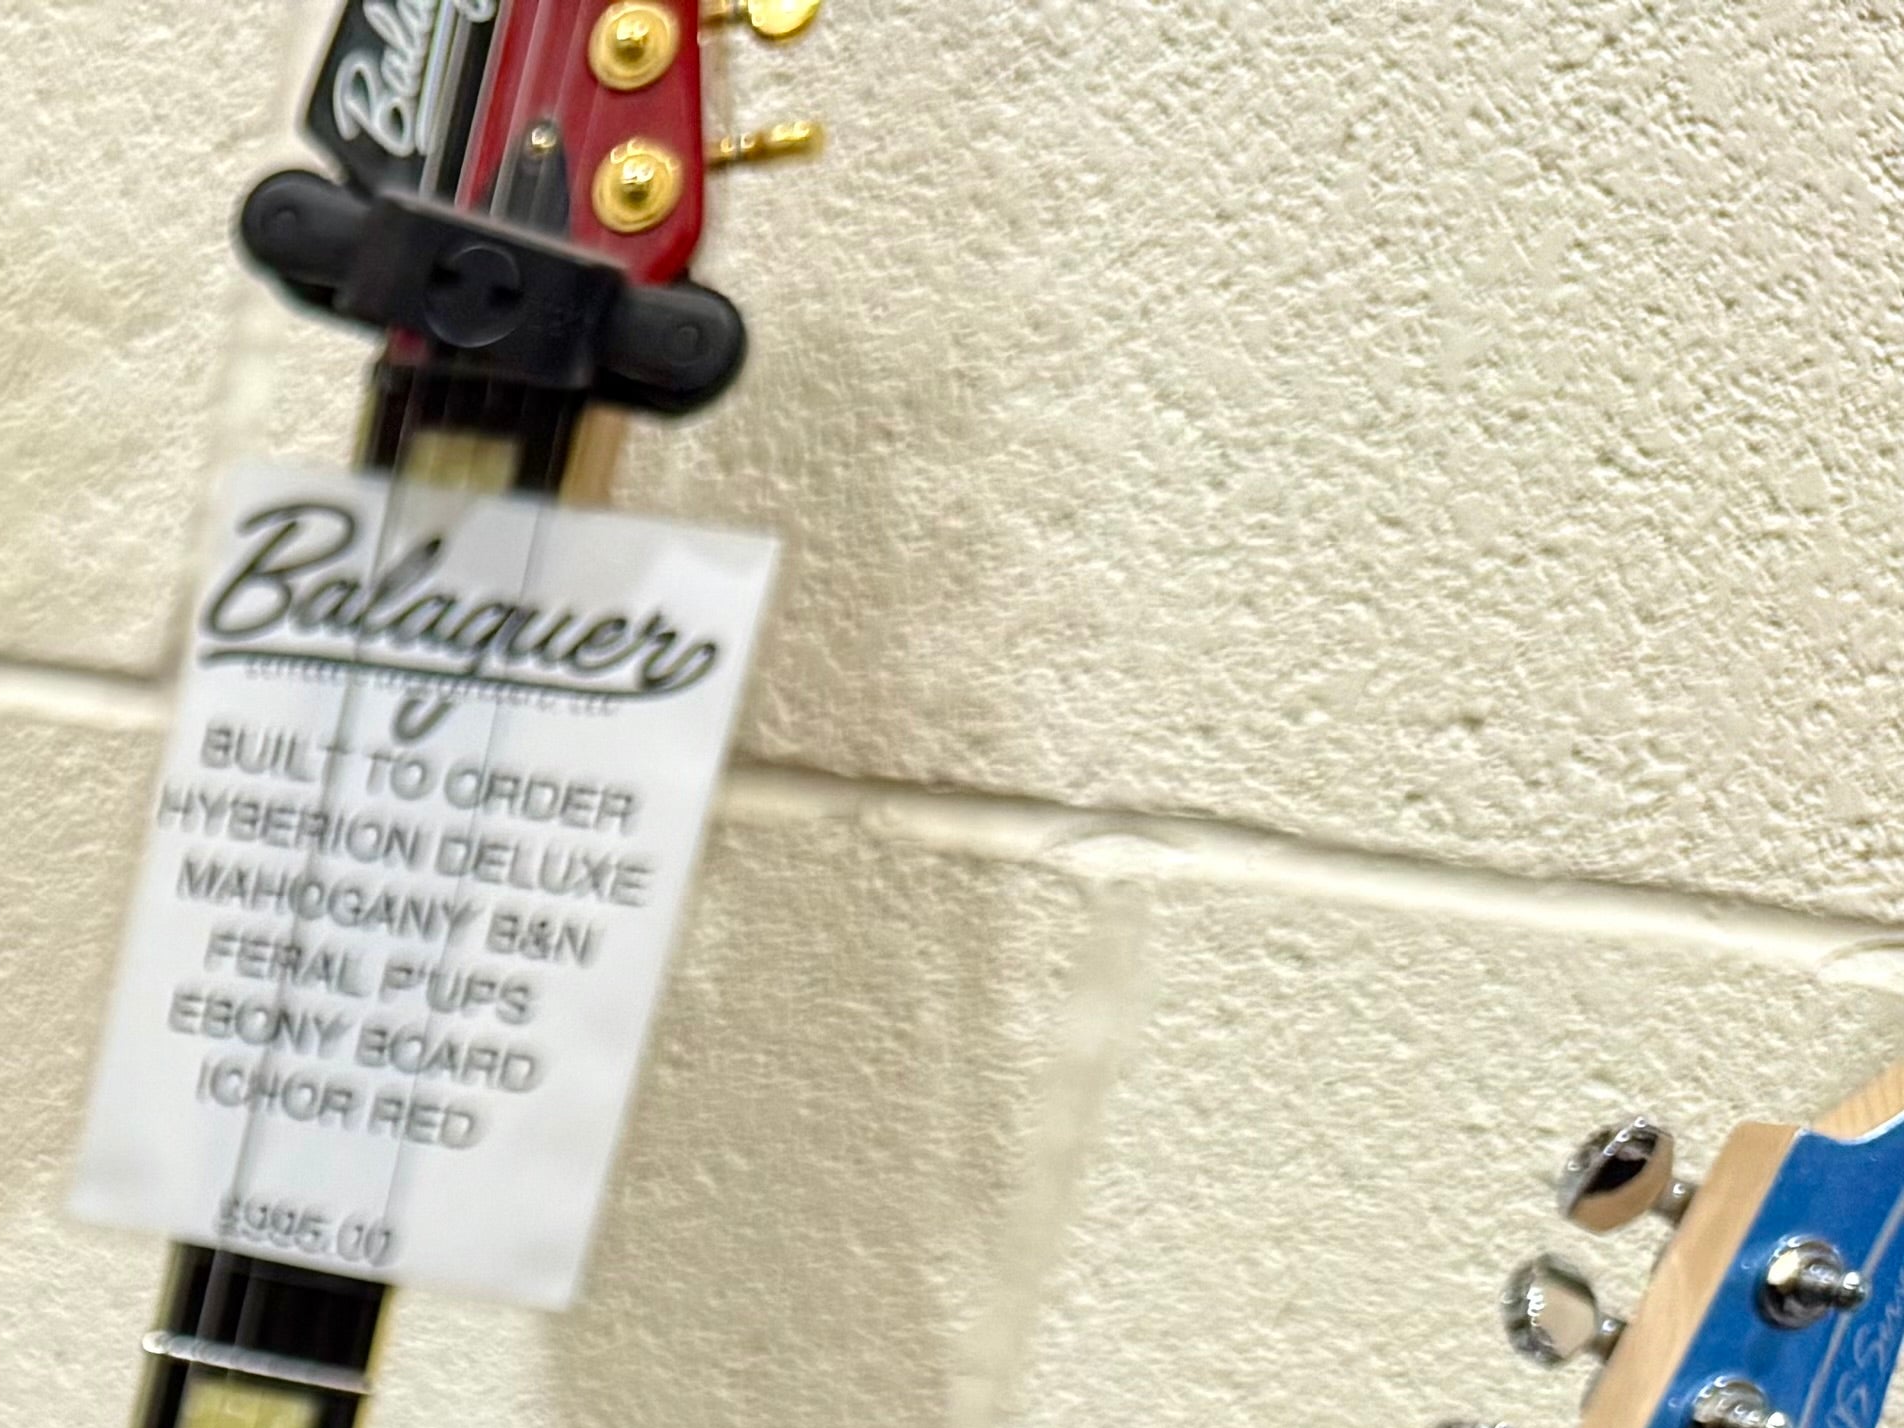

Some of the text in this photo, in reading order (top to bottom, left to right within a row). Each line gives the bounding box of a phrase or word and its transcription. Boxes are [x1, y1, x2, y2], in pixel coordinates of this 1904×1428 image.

[199, 502, 718, 739] Balaguer
[199, 723, 639, 833] BUILT TO ORDER
[175, 857, 601, 969] MAHOGANY B&N
[435, 834, 655, 908] DELUXE
[203, 924, 372, 999] FERAL
[168, 985, 548, 1095] EBONY BOARD
[194, 1059, 491, 1150] ICHOR RED
